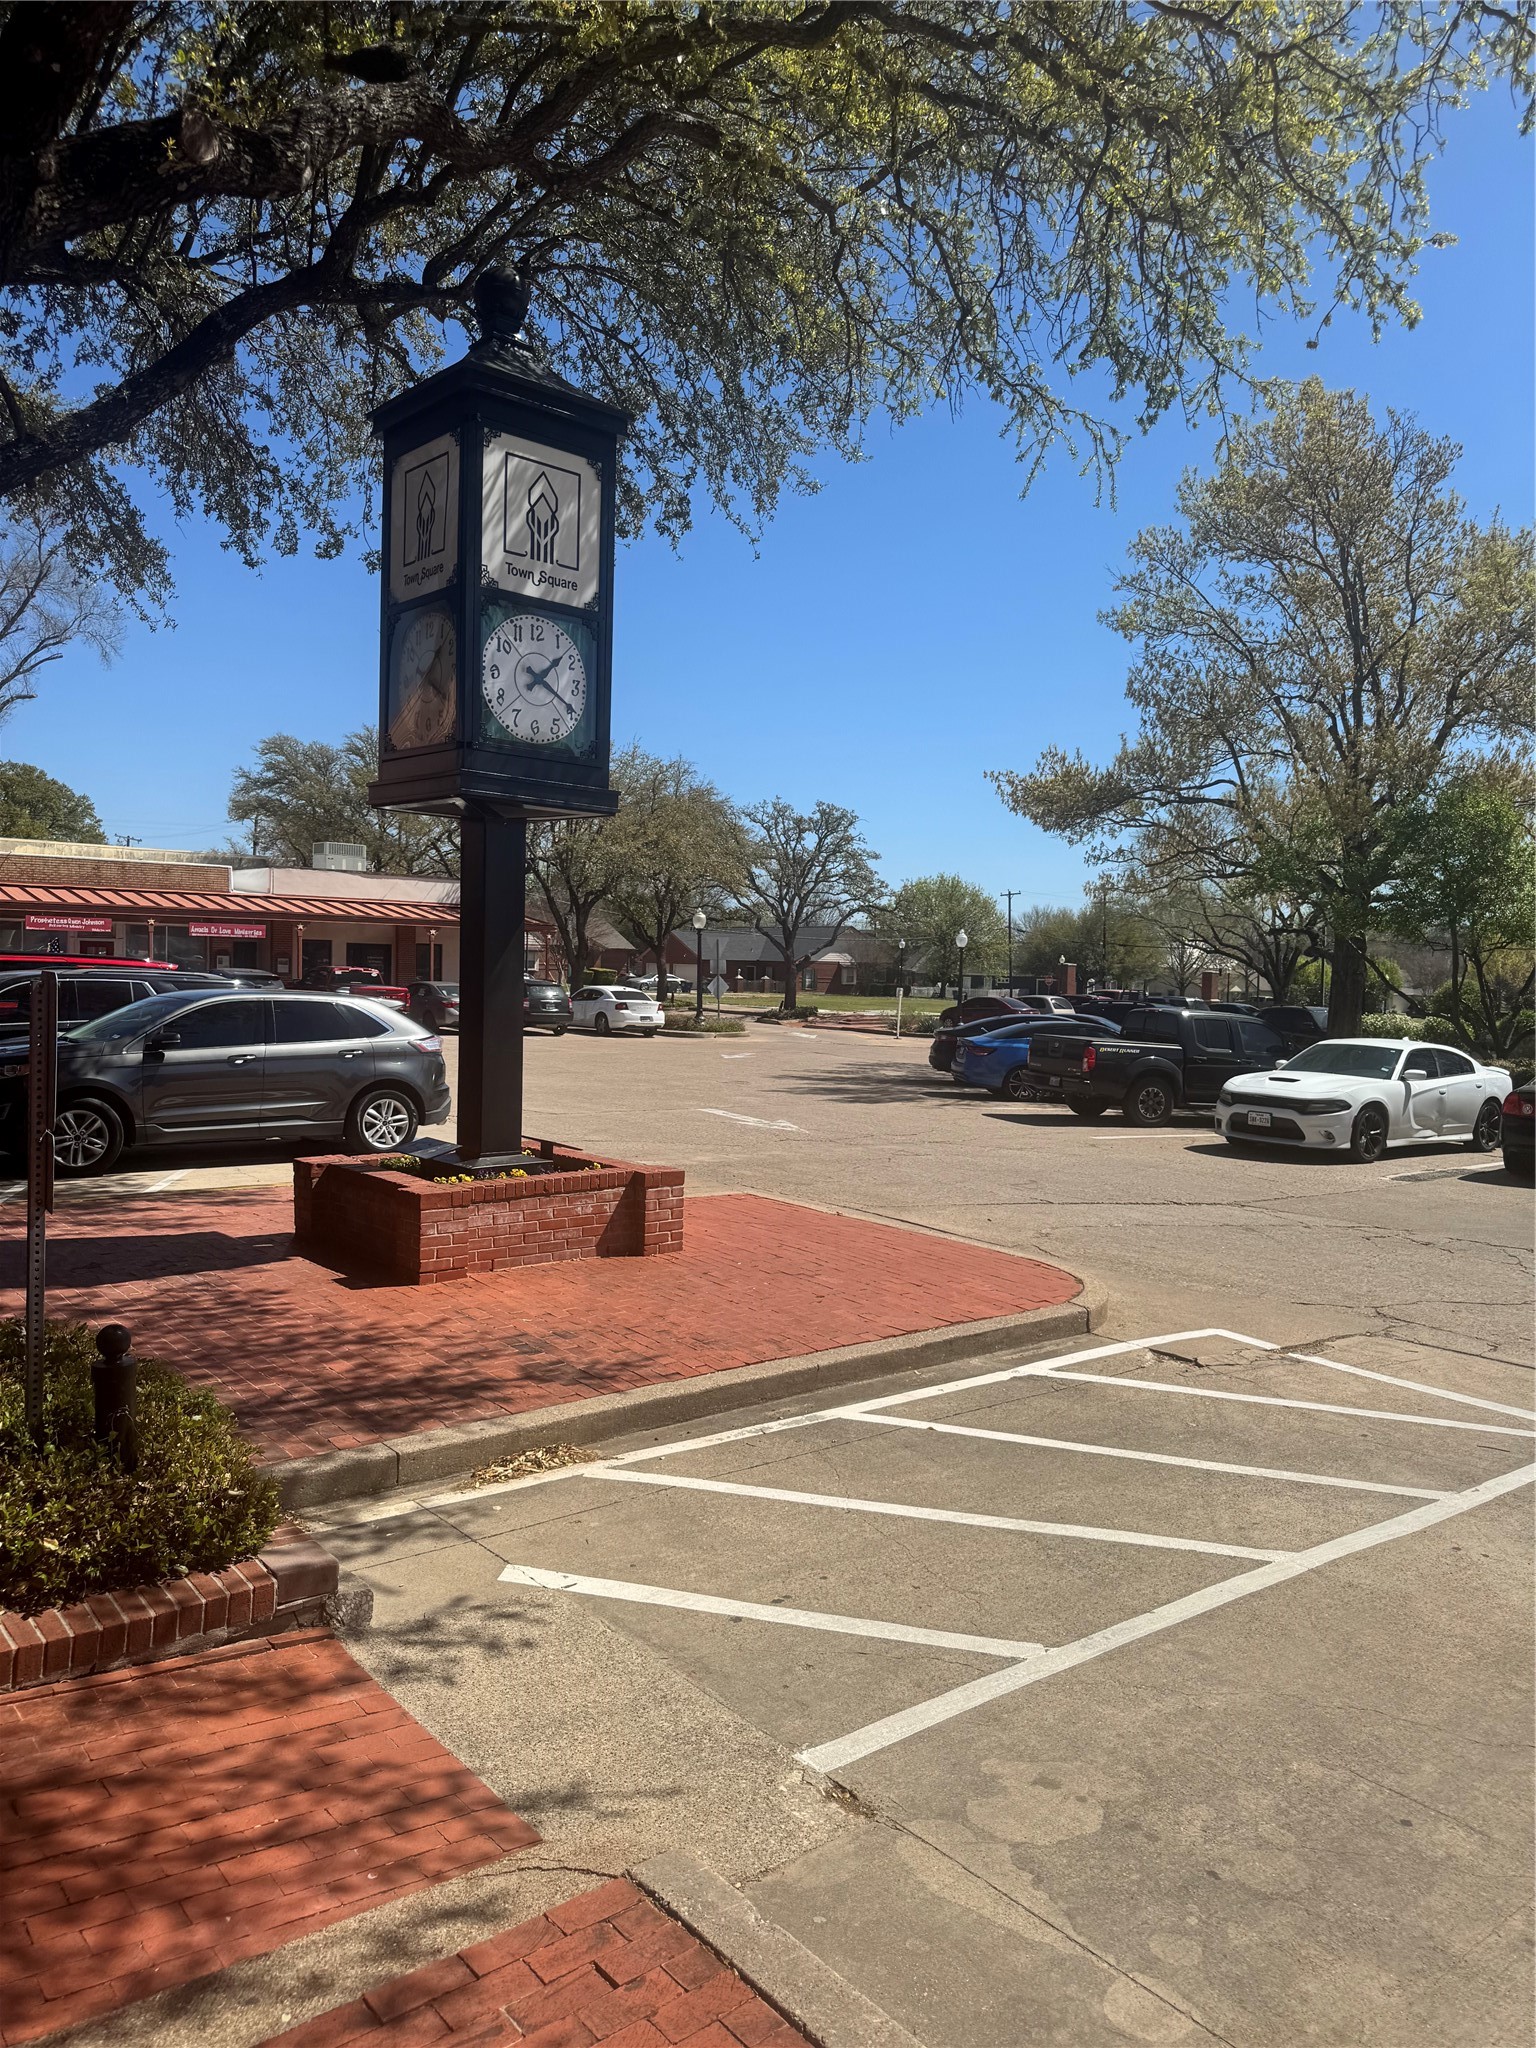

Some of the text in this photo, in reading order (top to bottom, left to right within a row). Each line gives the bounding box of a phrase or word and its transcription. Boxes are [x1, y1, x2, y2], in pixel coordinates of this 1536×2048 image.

[404, 563, 444, 586] Town Square
[505, 561, 578, 591] Town Square
[513, 623, 523, 642] 11
[530, 623, 545, 642] 12
[555, 633, 560, 650] 1
[496, 635, 512, 655] 10
[568, 654, 576, 671] 2
[489, 664, 500, 680] 9
[496, 688, 505, 706] 8
[571, 679, 581, 697] 3
[511, 708, 522, 728] 7
[550, 718, 561, 735] 5
[530, 719, 540, 736] 6
[219, 926, 232, 935] Love
